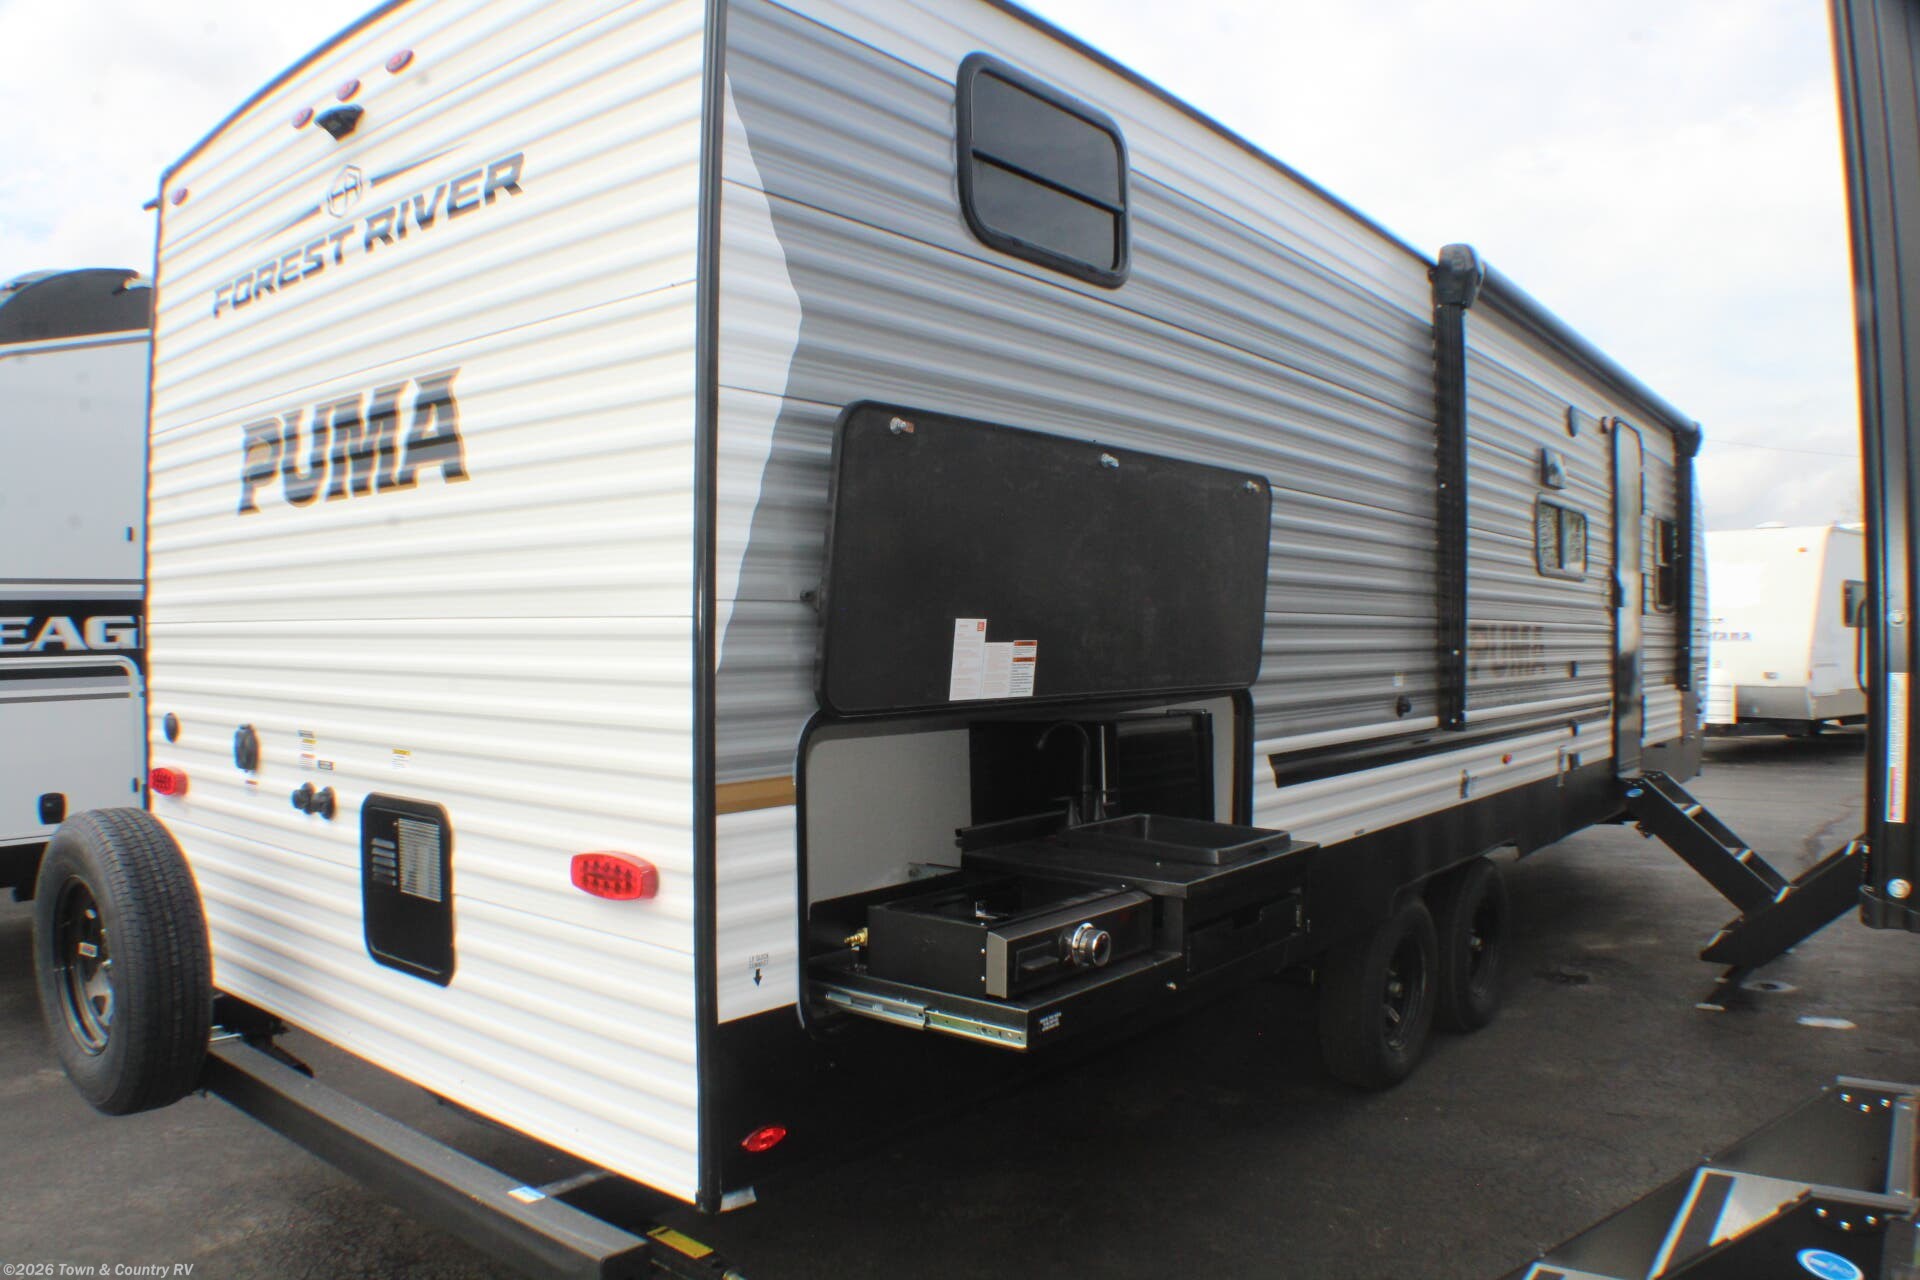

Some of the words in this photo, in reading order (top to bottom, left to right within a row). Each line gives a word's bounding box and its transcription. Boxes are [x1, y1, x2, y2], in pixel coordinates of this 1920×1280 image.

[213, 224, 355, 318] FOREST
[364, 152, 524, 252] RIVER
[238, 366, 470, 516] PUMA
[0, 615, 143, 652] EAG
